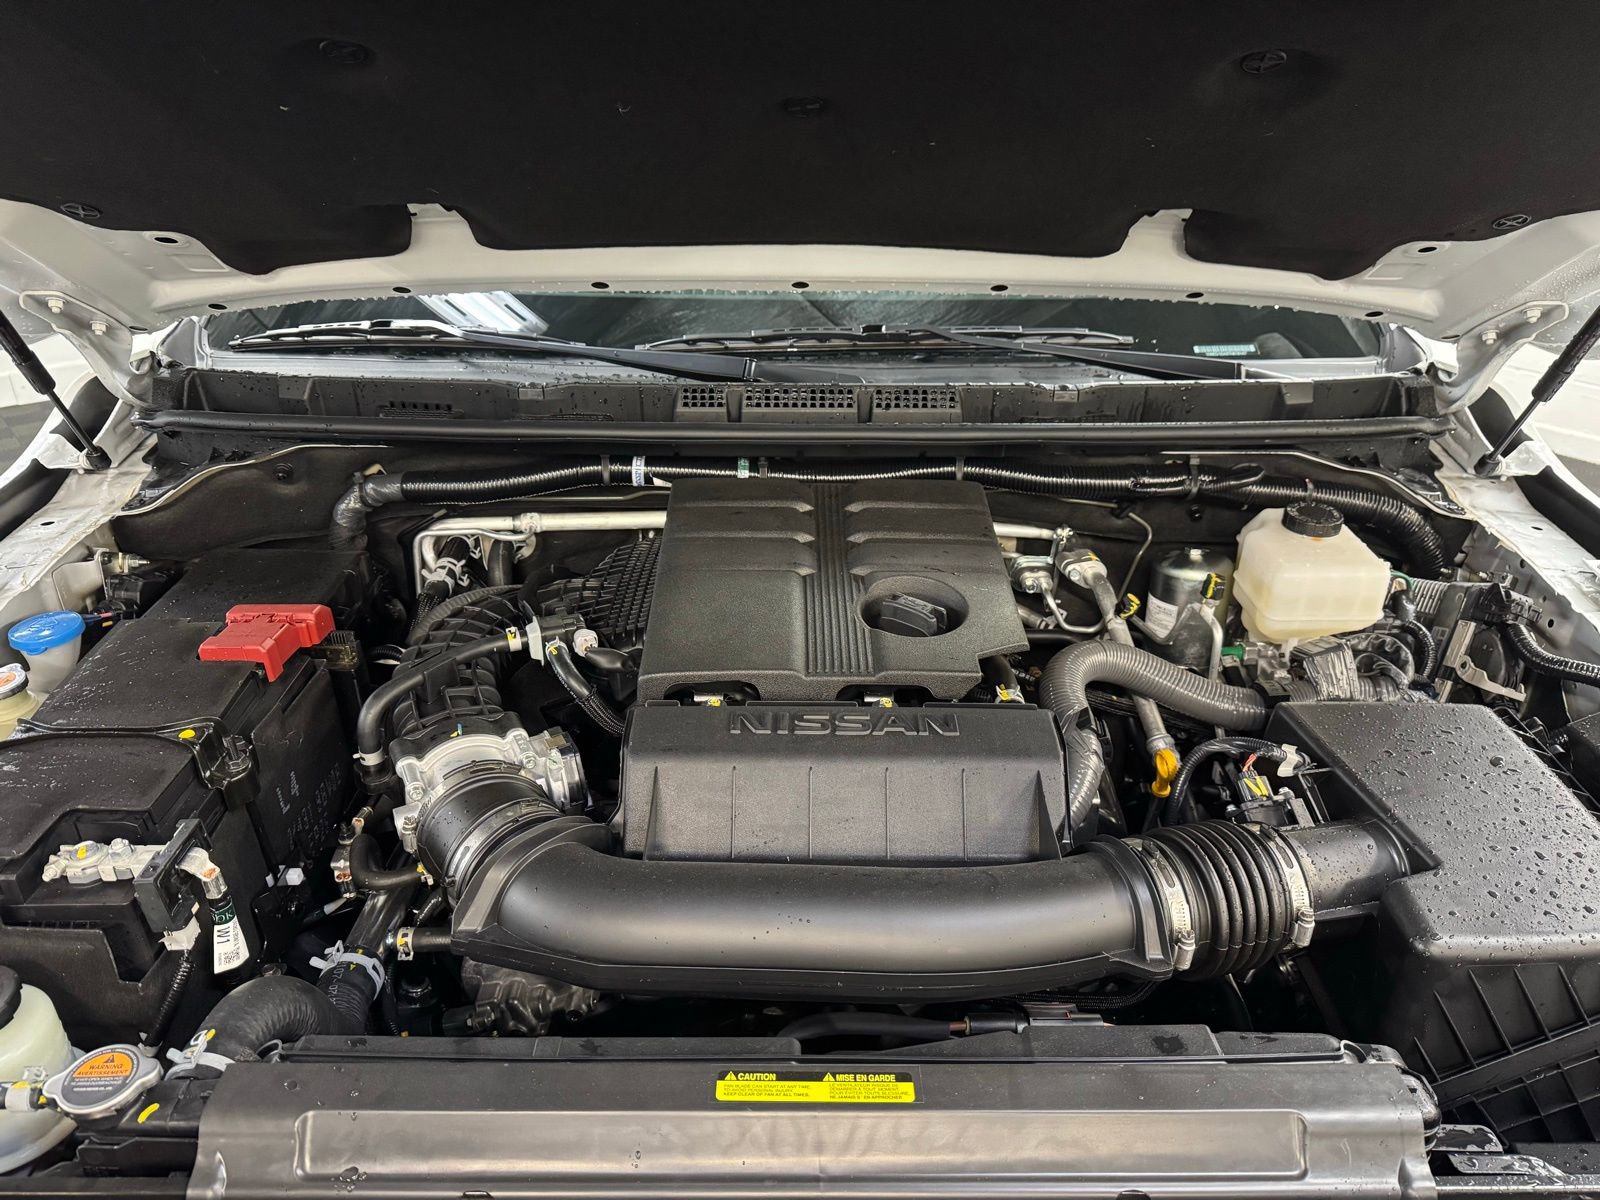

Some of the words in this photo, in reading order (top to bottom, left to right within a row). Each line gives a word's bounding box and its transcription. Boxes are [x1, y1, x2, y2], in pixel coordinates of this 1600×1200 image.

[729, 711, 961, 736] NISSAN
[216, 926, 231, 945] W1
[737, 1073, 777, 1081] CAUTION
[835, 1074, 855, 1082] MISE
[856, 1074, 867, 1082] EN
[868, 1074, 897, 1082] GARDE
